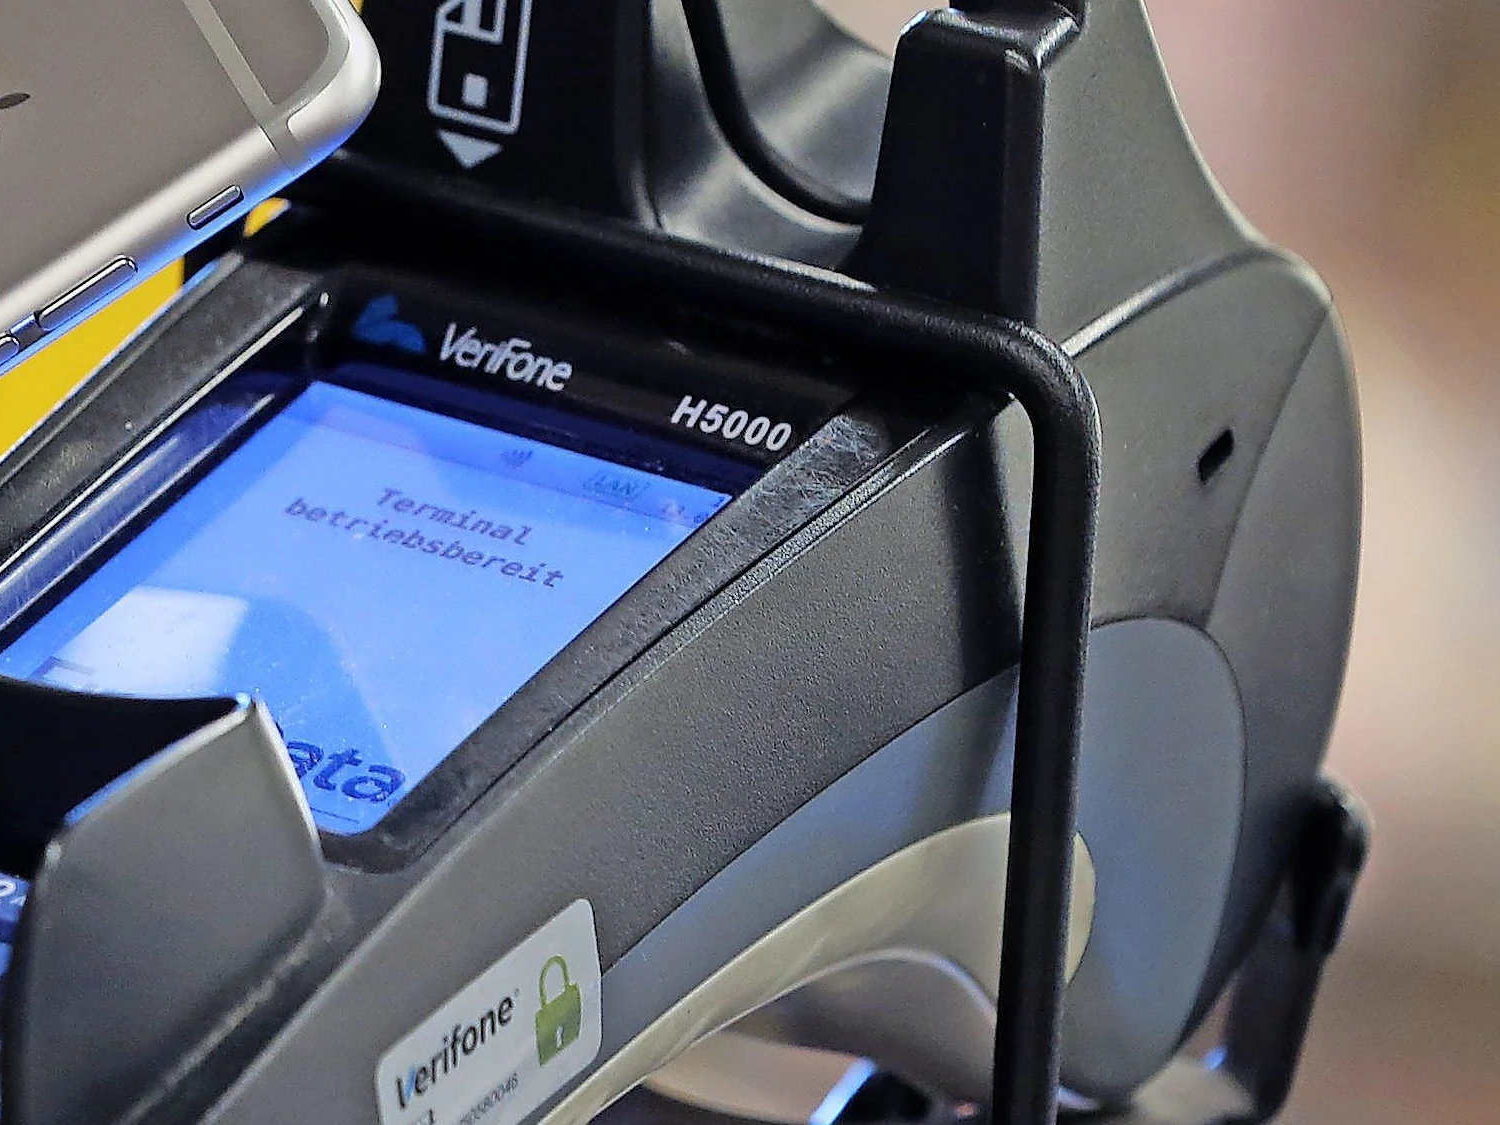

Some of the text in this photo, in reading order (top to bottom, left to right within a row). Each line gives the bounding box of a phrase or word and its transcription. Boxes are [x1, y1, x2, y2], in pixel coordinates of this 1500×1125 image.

[439, 322, 573, 392] VeriFone
[670, 394, 793, 452] H5000
[284, 497, 565, 588] betriebsbereit
[376, 487, 533, 546] Terminal
[395, 996, 514, 1109] Verifone
